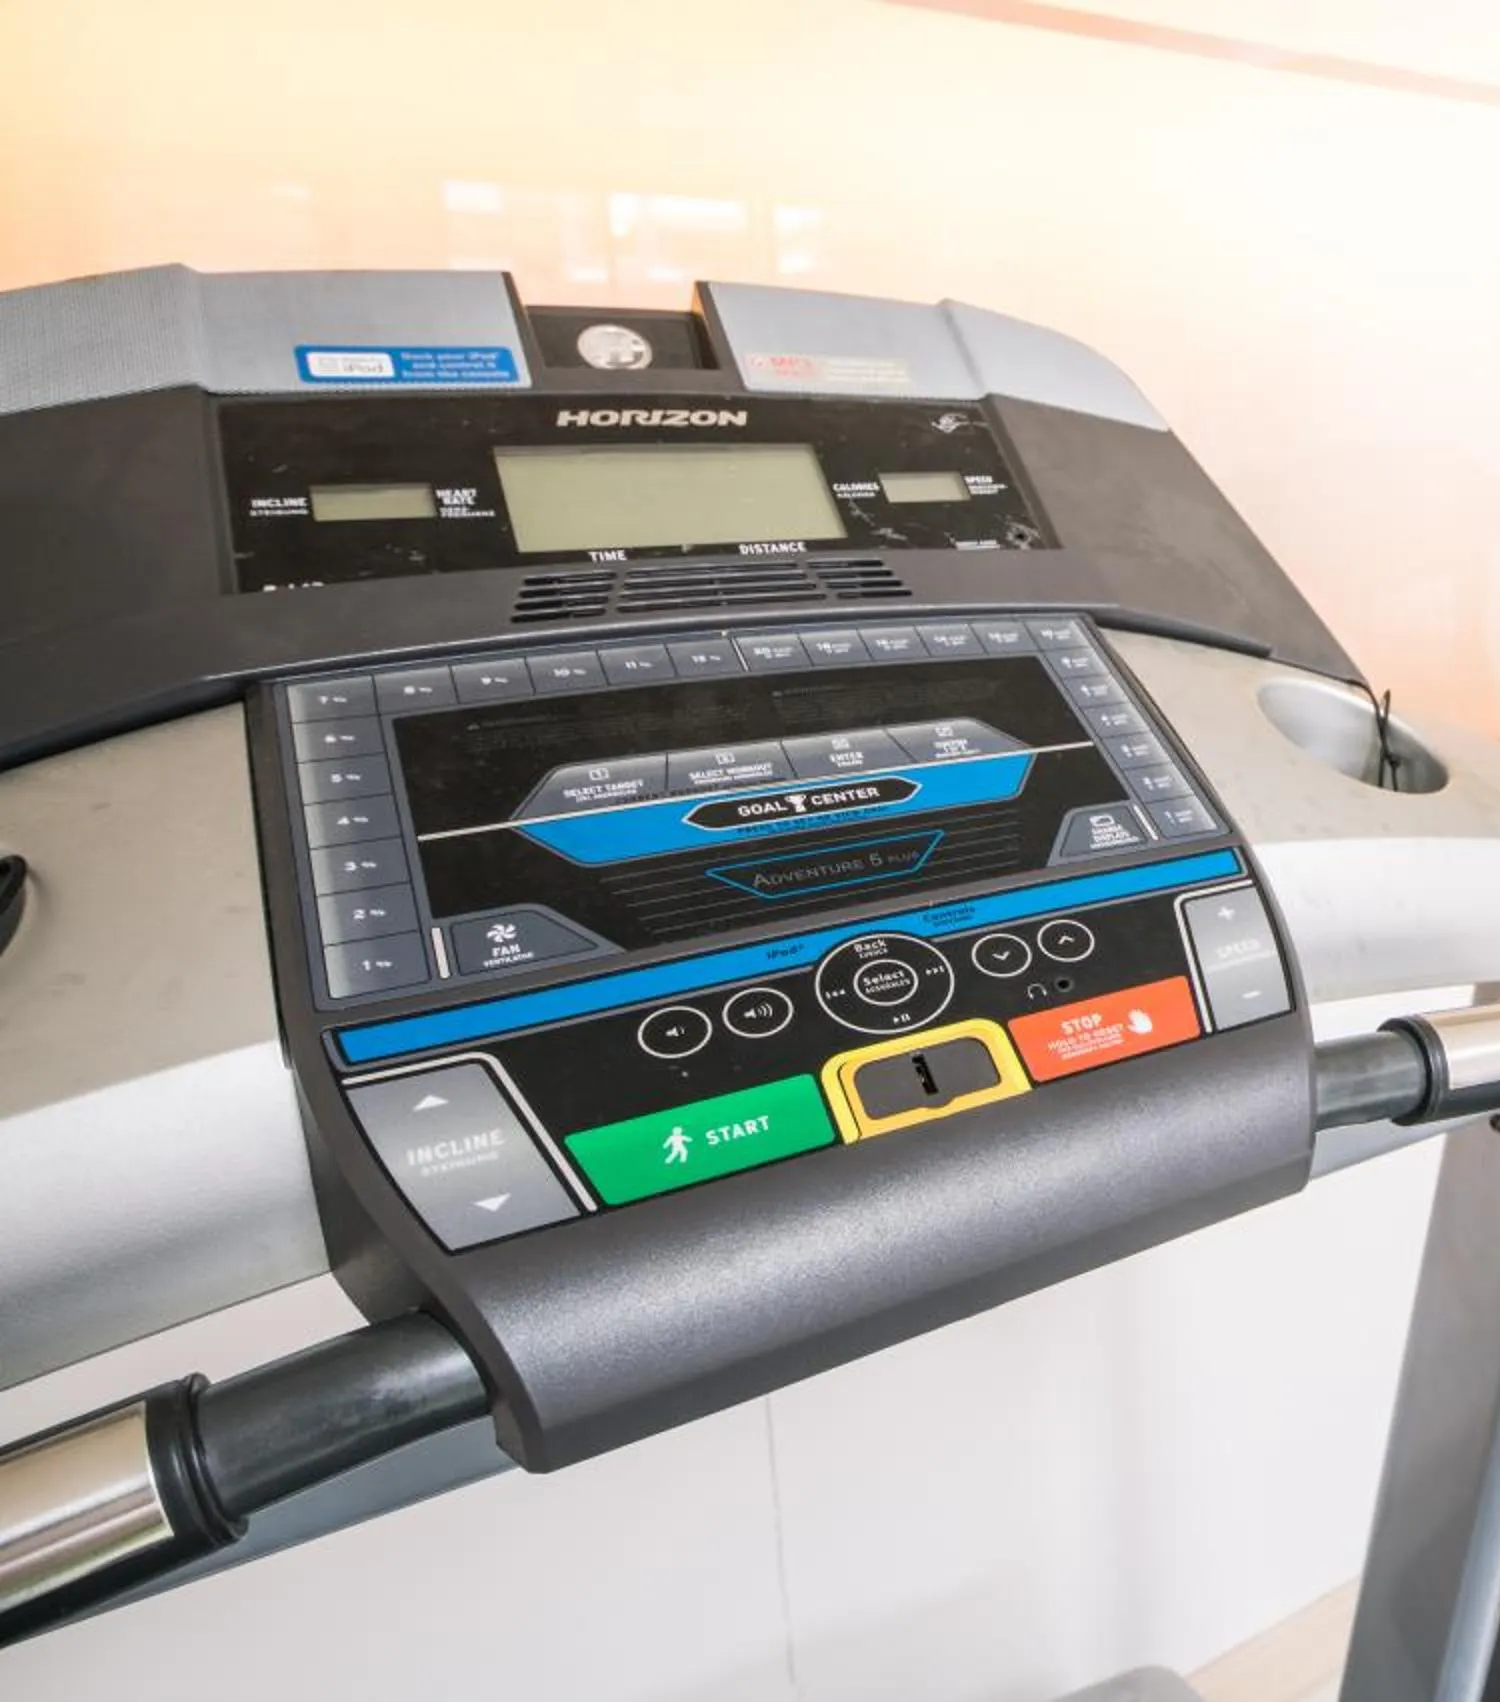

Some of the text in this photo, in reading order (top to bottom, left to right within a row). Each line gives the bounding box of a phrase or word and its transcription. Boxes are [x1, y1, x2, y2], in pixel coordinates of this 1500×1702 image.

[556, 409, 748, 427] HORIZON
[435, 487, 477, 498] HEART
[251, 497, 308, 508] INCLINE
[588, 549, 628, 563] TIME
[739, 541, 807, 556] DISTANCE
[829, 751, 864, 763] ENTER
[689, 767, 727, 781] SELECT
[564, 783, 603, 800] SELECT
[604, 778, 645, 792] TARGET
[737, 786, 880, 817] GOAL CENTER
[868, 850, 884, 868] 5
[492, 943, 520, 957] FAN
[854, 939, 888, 953] Back
[863, 970, 904, 987] Select
[1060, 1012, 1103, 1036] STOP
[705, 1115, 770, 1145] START
[406, 1127, 506, 1167] INCLINE
